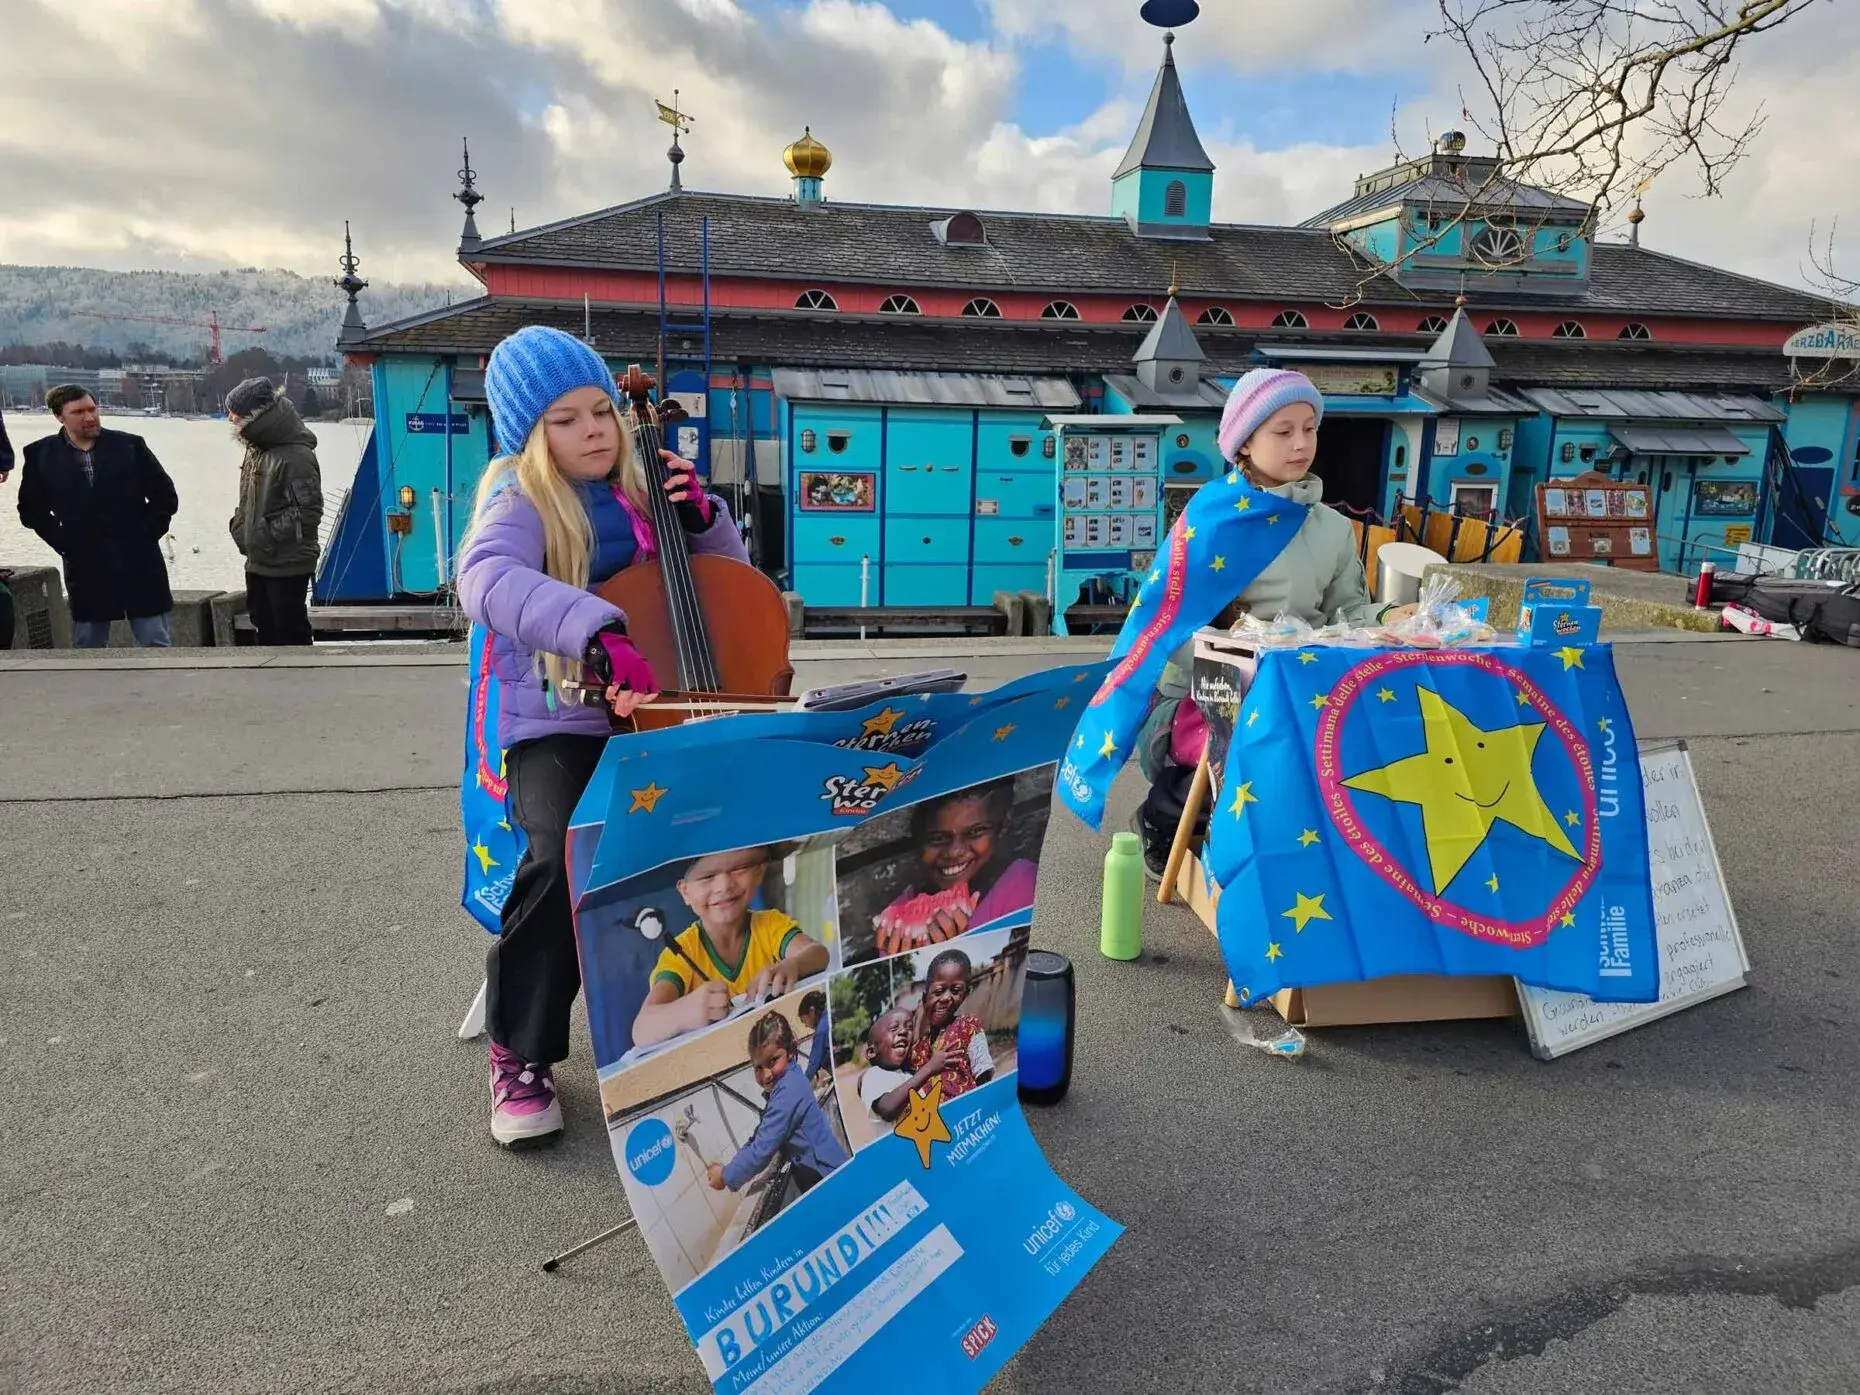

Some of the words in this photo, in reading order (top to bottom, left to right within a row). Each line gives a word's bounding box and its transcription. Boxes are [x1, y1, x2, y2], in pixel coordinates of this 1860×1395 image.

[1321, 708, 1340, 778] Settimana
[1332, 679, 1357, 707] delle
[1355, 660, 1384, 682] stelle
[1555, 719, 1576, 741] des
[820, 776, 888, 800] Ster
[1330, 792, 1362, 841] étoiles
[1360, 840, 1383, 865] des
[1560, 880, 1584, 909] delle
[1606, 905, 1631, 968] Familie
[945, 1111, 1002, 1168] MITMACHEN!
[953, 1107, 982, 1140] JETZT
[629, 1138, 662, 1172] unicef
[1022, 1209, 1063, 1256] unicef
[1043, 1260, 1061, 1277] für
[1058, 1239, 1083, 1267] jedes
[1075, 1219, 1101, 1242] Kind
[703, 1298, 737, 1324] Kinder
[734, 1277, 763, 1300] helfen
[760, 1257, 794, 1282] Kindern
[794, 1248, 805, 1259] in
[715, 1203, 899, 1369] BURUNDI!!!
[792, 1312, 825, 1340] Aktion:
[962, 1315, 996, 1356] SPICK
